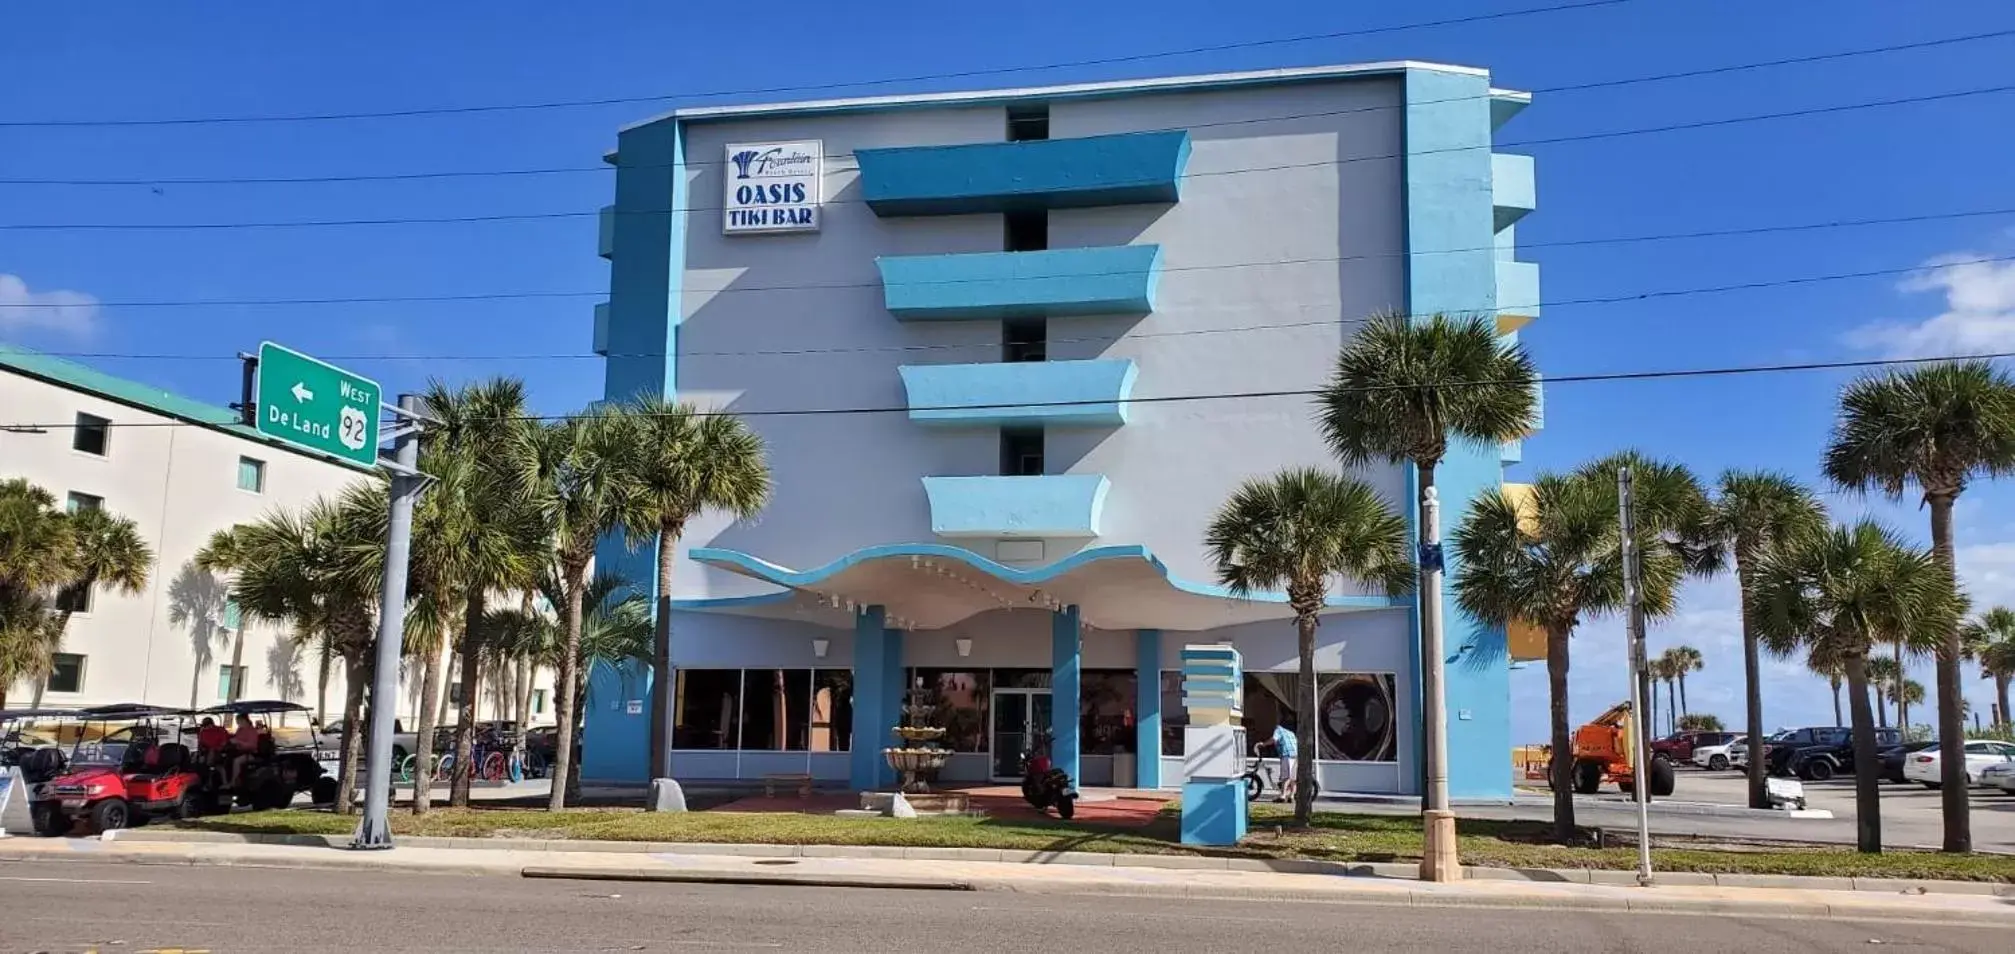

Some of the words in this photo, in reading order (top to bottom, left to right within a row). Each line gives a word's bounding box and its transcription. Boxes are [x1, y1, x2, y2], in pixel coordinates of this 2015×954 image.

[754, 147, 812, 174] Fountain
[737, 182, 806, 205] OASIS
[729, 210, 768, 226] TIKI
[772, 207, 812, 225] BAR
[340, 380, 371, 405] WEST
[343, 415, 365, 442] 92
